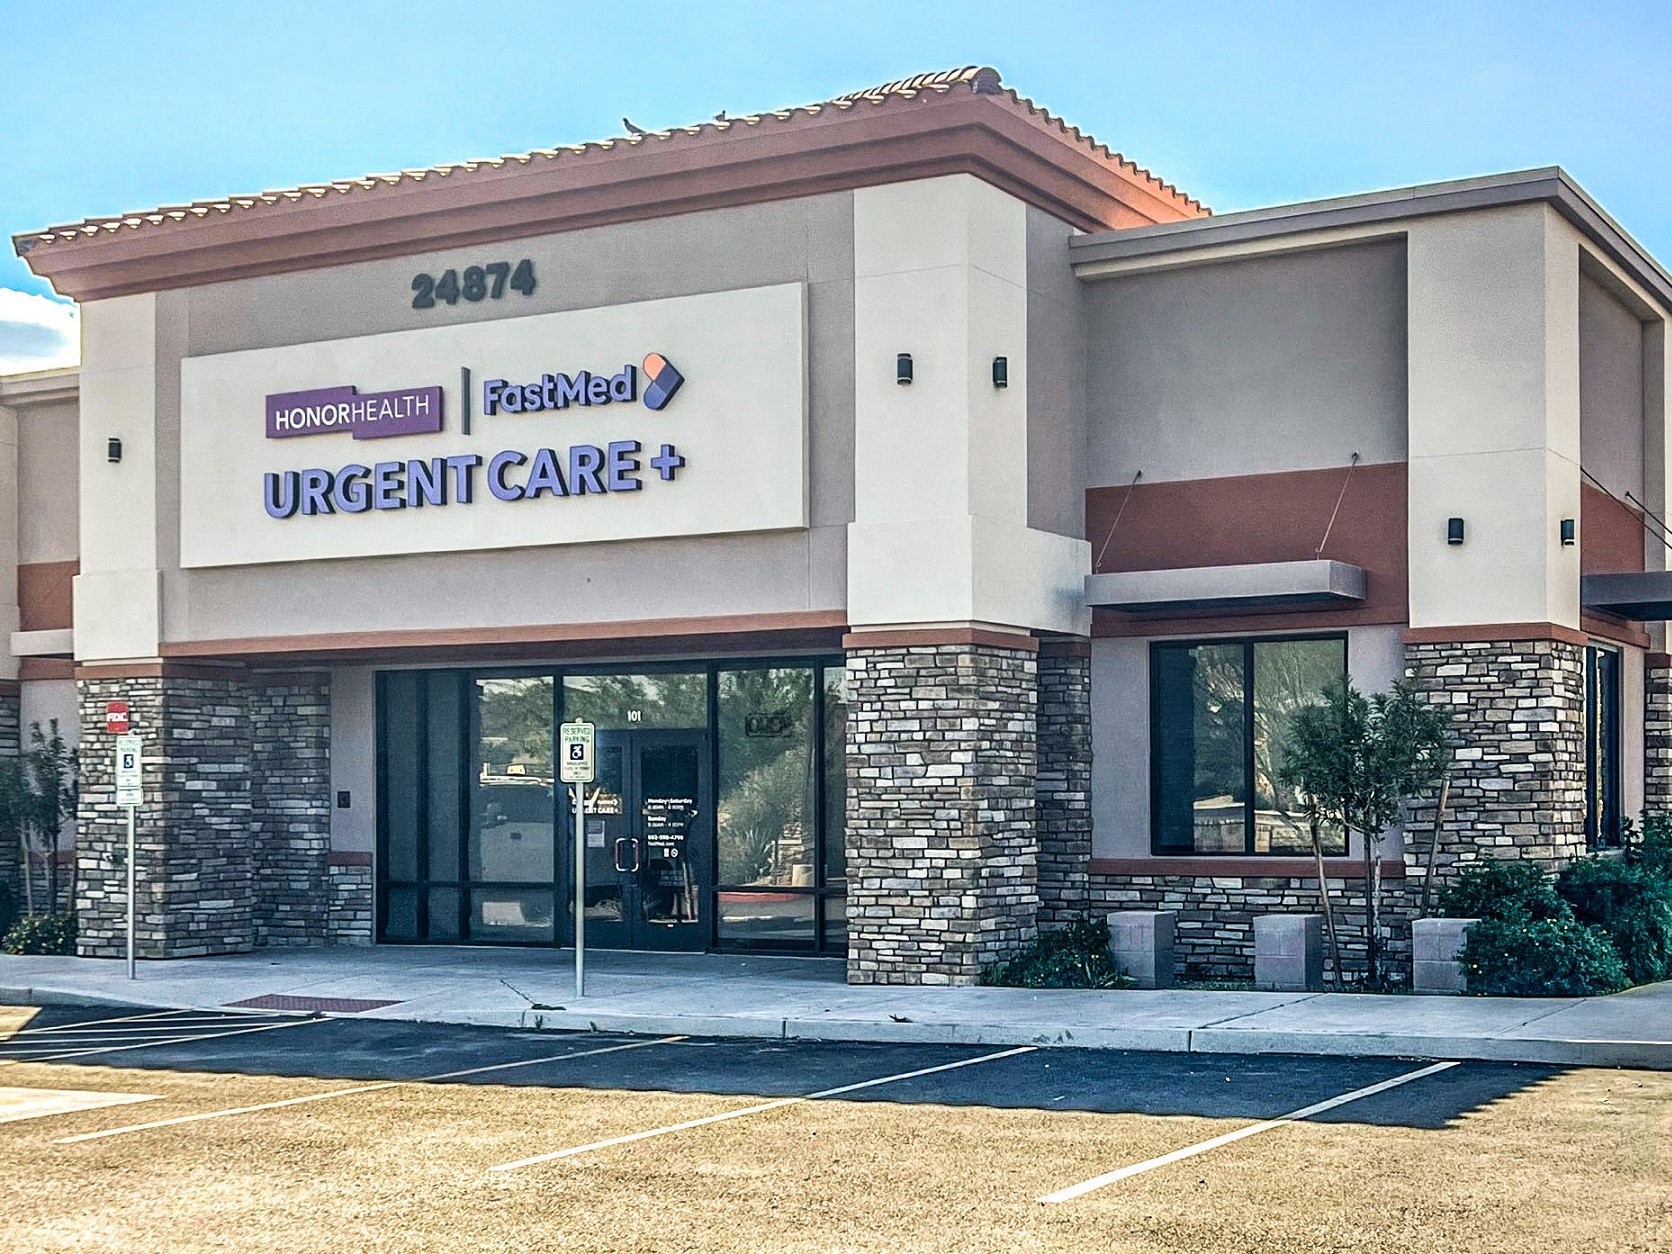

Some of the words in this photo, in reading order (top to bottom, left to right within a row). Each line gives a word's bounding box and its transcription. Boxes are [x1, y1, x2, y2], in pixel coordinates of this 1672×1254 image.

[411, 259, 536, 308] 24874
[275, 394, 430, 431] HONORHEALTH
[484, 364, 637, 415] FastMed
[264, 454, 482, 519] URGENT
[488, 440, 642, 501] CARE
[627, 710, 641, 721] 101
[564, 727, 590, 735] RESERVED
[565, 735, 590, 743] PARKING
